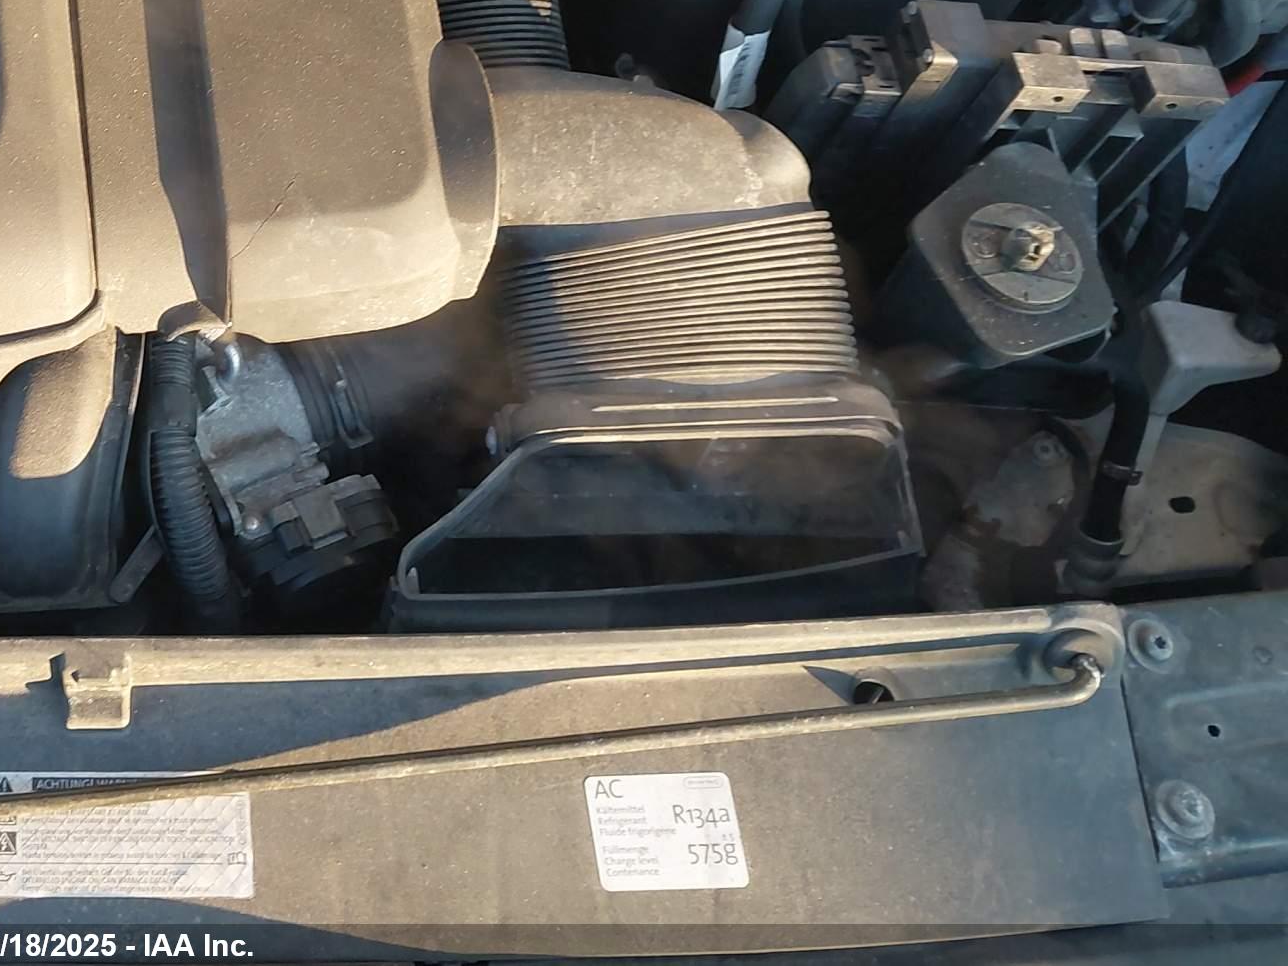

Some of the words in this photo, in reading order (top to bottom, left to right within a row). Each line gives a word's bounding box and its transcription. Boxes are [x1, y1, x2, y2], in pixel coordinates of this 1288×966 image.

[595, 779, 624, 799] AC
[672, 804, 731, 829] R134a
[687, 843, 739, 866] 575g
